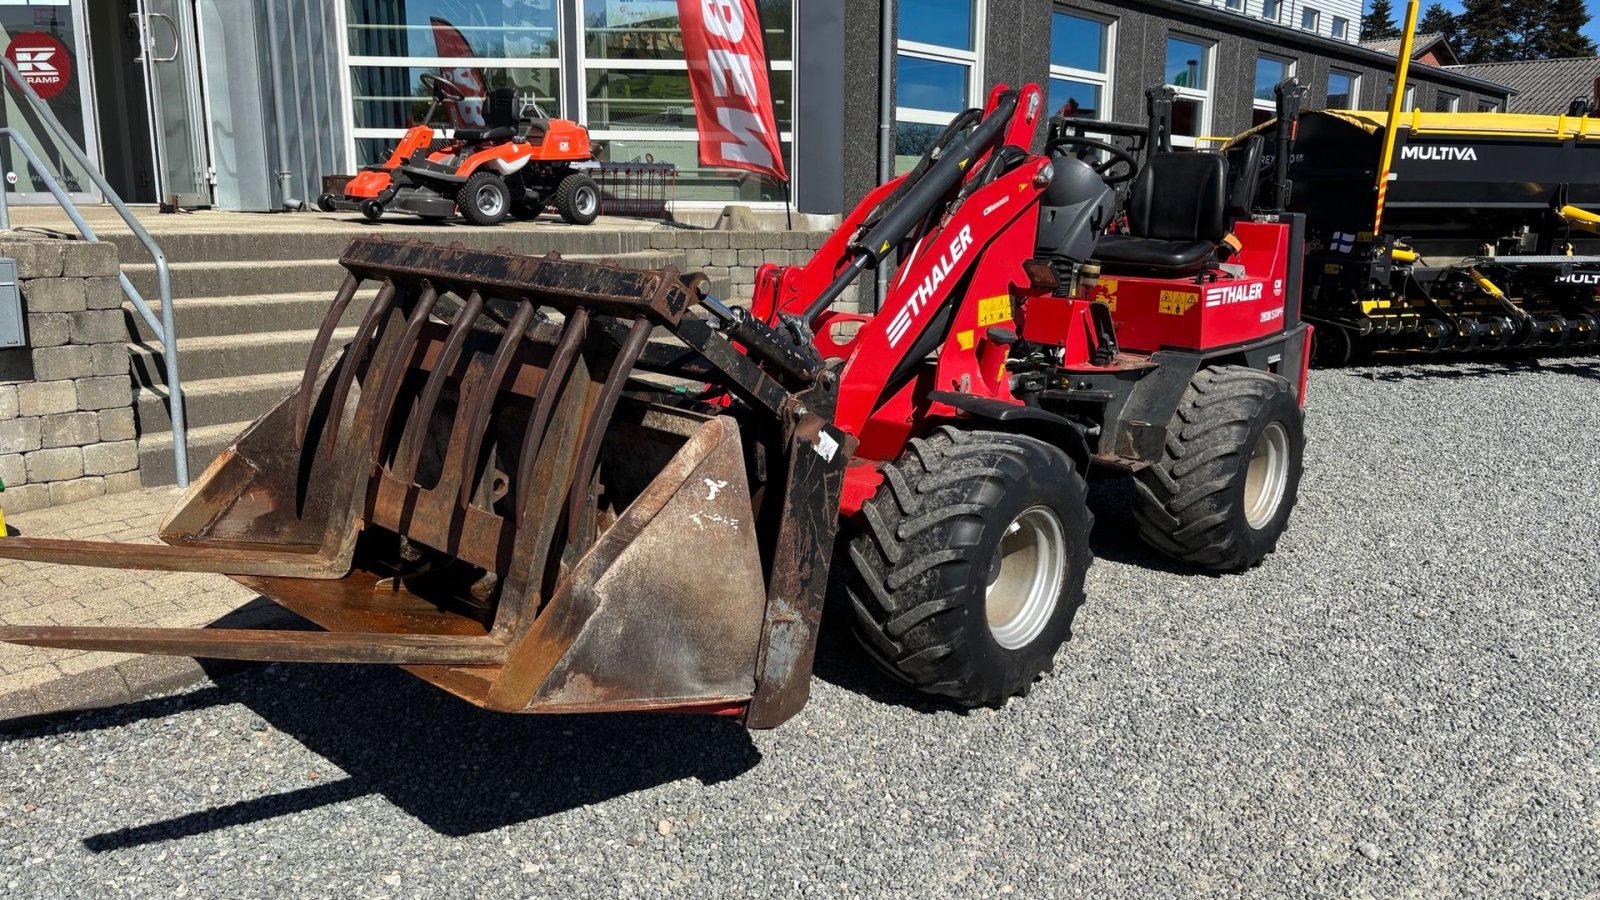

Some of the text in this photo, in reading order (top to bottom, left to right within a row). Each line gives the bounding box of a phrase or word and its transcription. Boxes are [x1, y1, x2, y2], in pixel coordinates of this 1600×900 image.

[25, 76, 60, 84] RAMP
[1401, 145, 1478, 161] MULTIVA
[907, 224, 974, 317] THALER
[1221, 282, 1263, 305] THALER
